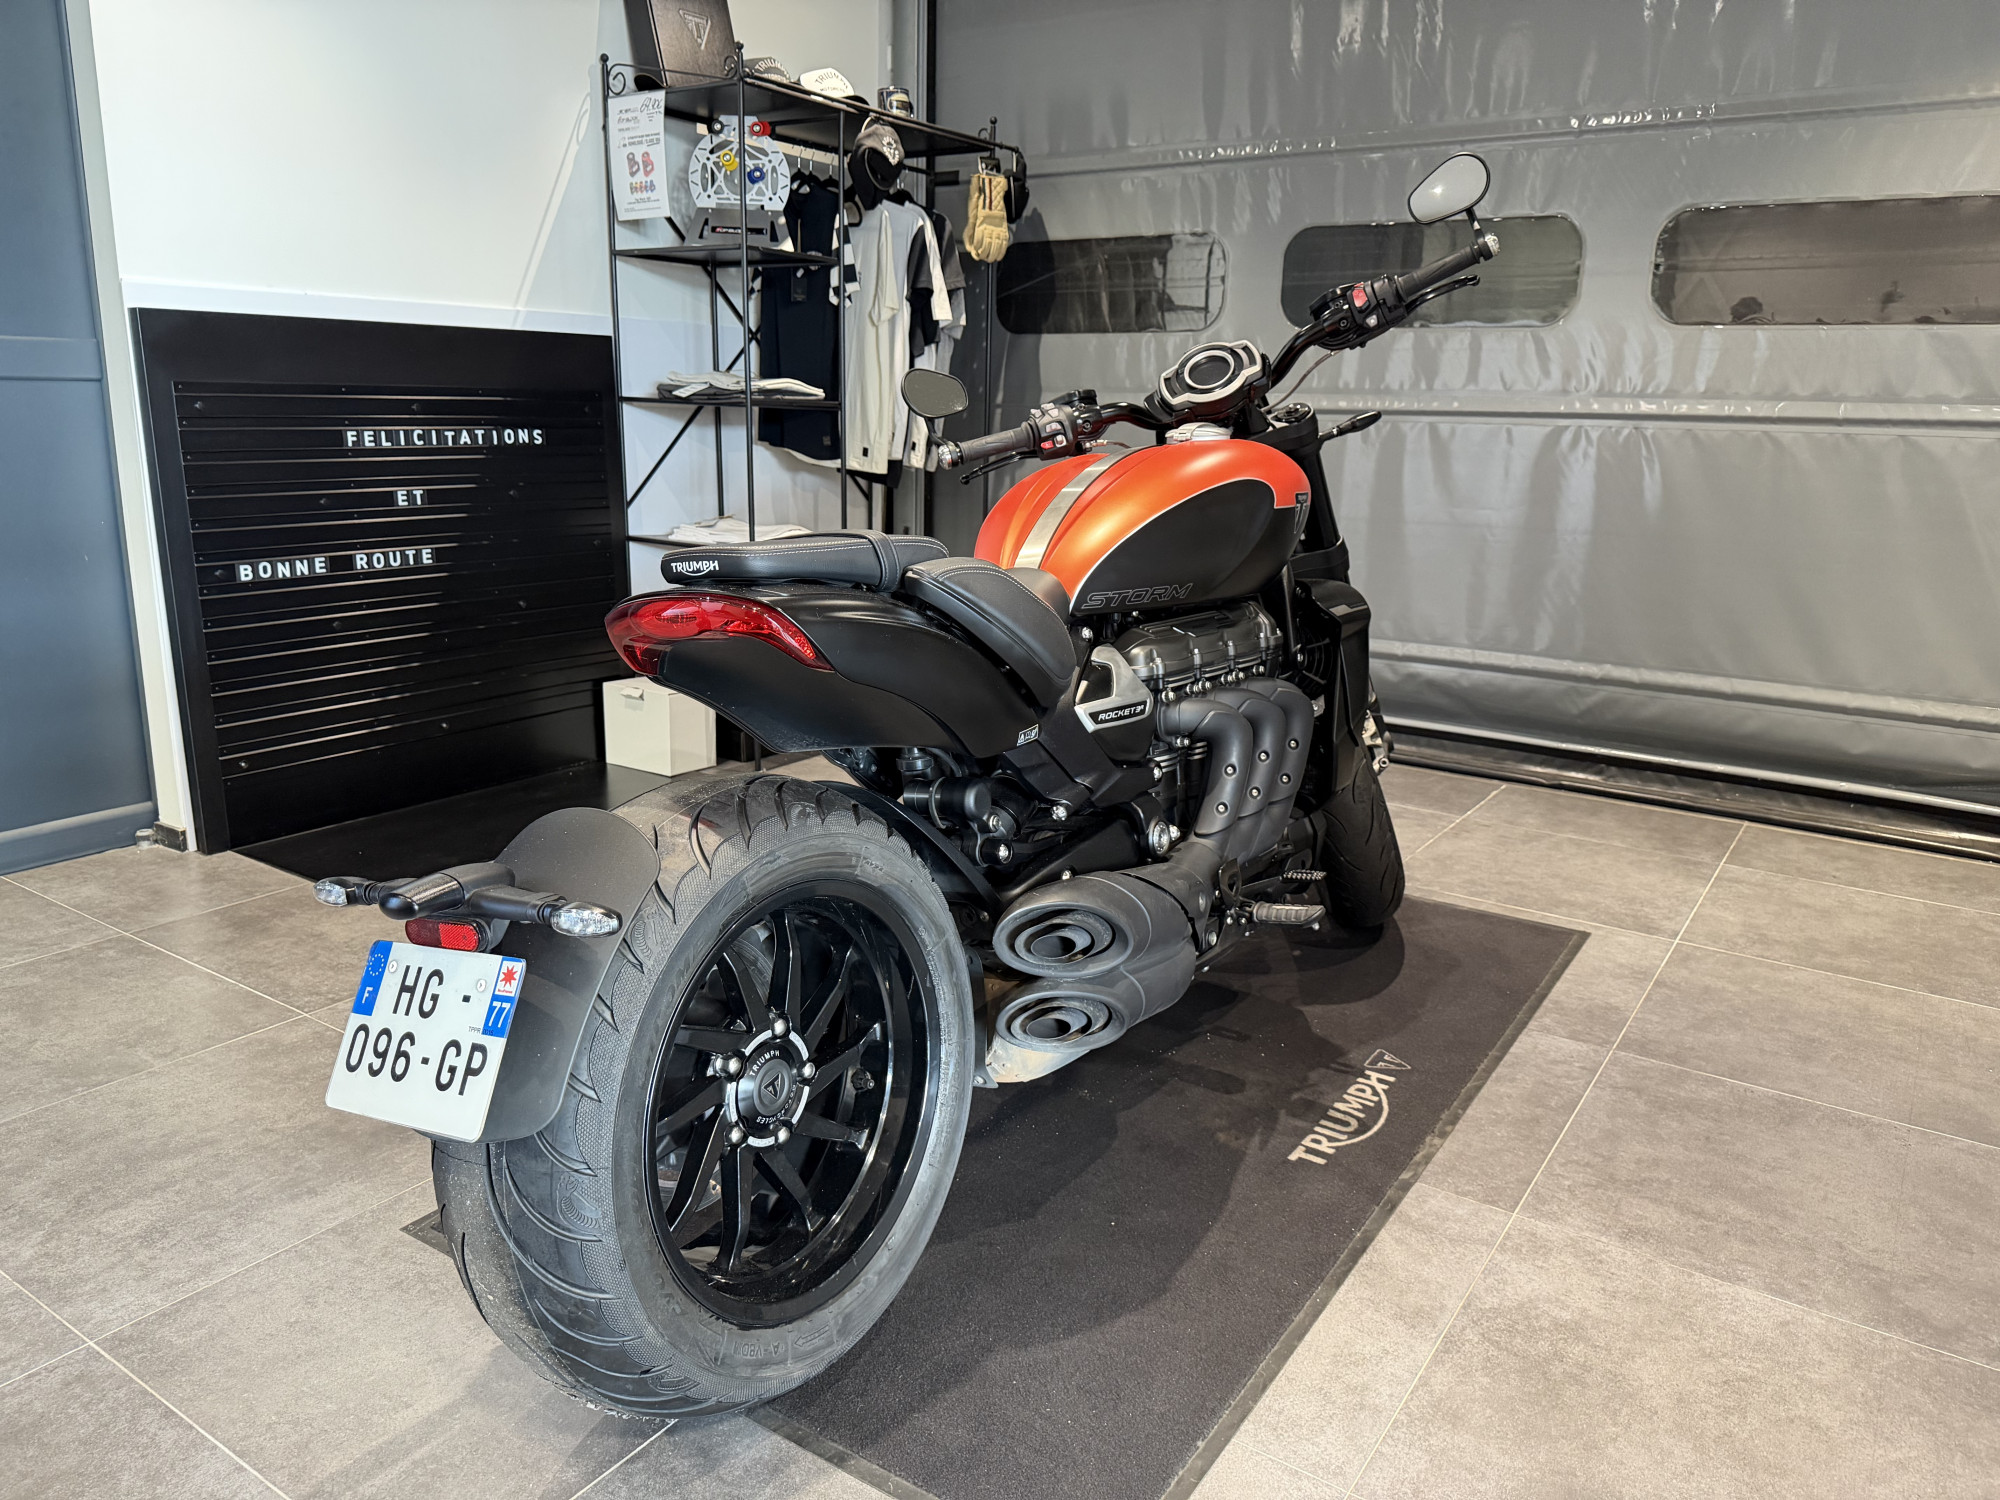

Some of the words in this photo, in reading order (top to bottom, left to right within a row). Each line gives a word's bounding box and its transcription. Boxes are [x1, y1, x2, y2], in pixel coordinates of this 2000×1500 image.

[346, 427, 543, 448] FELICITATIONS
[396, 488, 424, 507] ET
[239, 557, 327, 582] BONNE
[355, 547, 433, 570] ROUTE
[671, 560, 719, 576] TRIUMPH
[1081, 583, 1194, 609] STORM
[361, 986, 373, 1004] F
[488, 1001, 511, 1028] 77
[345, 1023, 488, 1096] 096-GP
[749, 1050, 780, 1076] TRIUMPH
[1287, 1070, 1397, 1165] TRIUMPH
